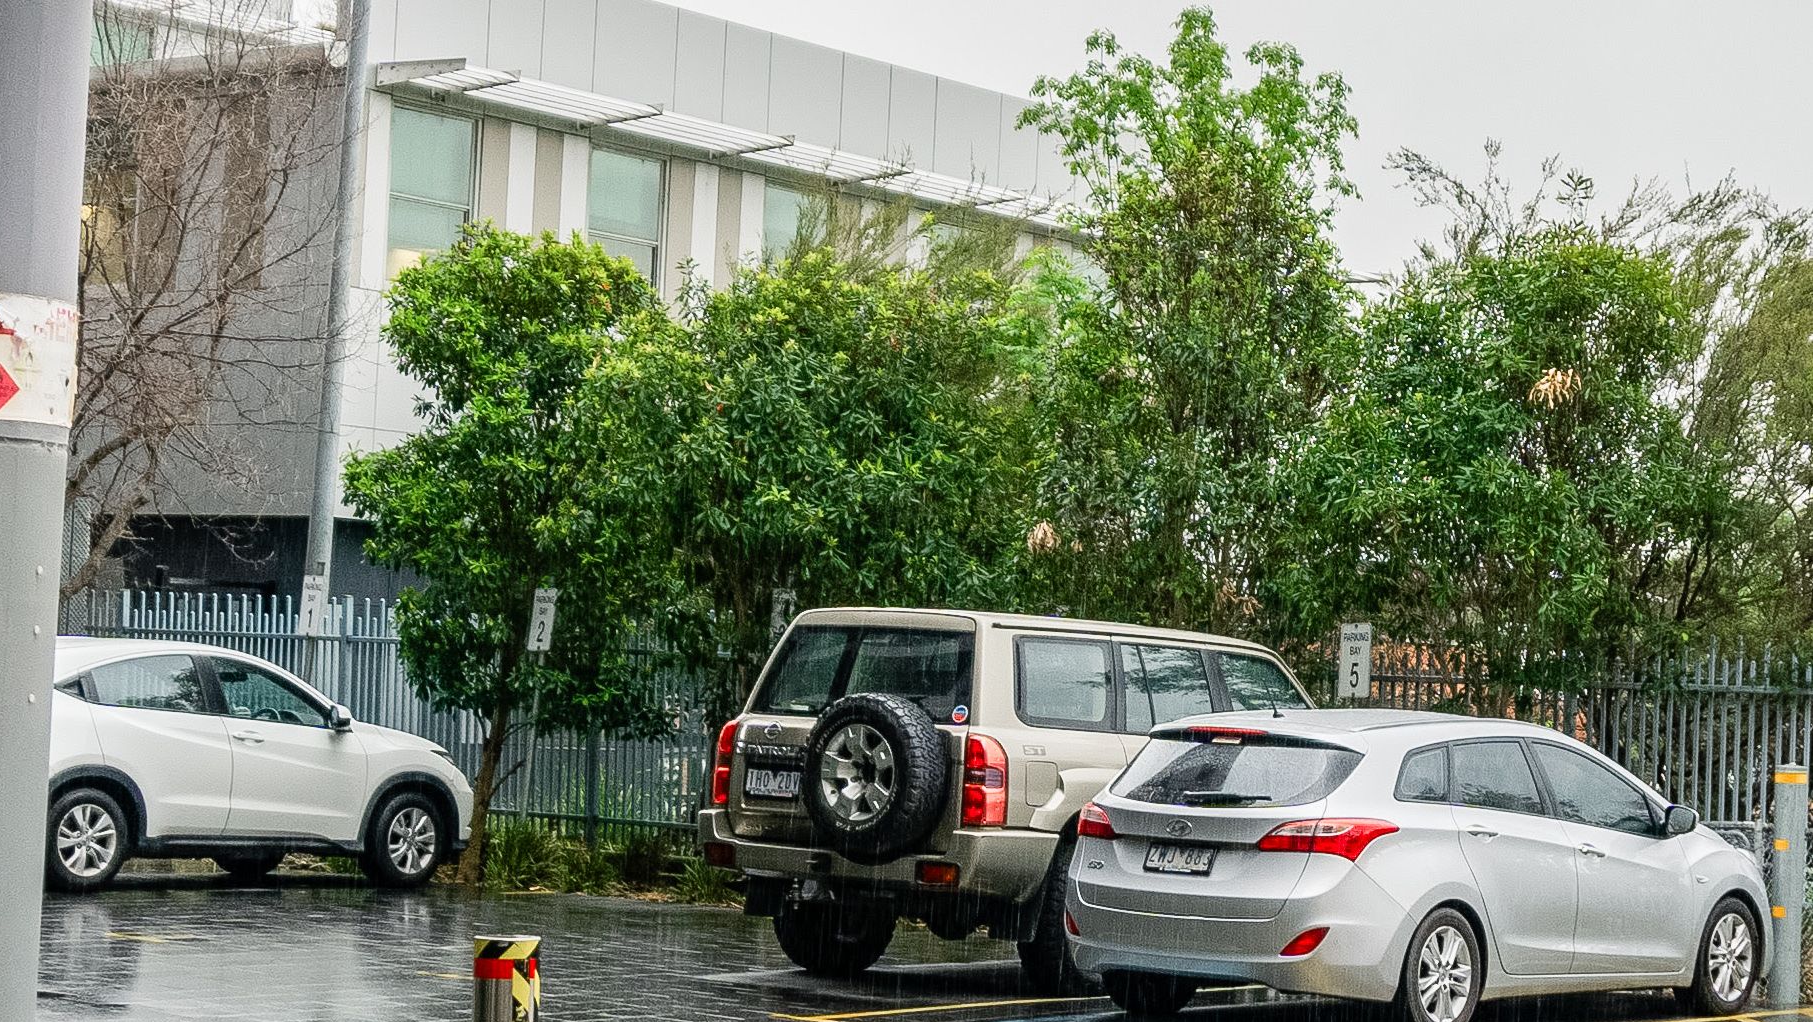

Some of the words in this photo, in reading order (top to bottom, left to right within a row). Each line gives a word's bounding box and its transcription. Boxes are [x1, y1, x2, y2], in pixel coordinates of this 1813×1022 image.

[308, 608, 313, 628] 1
[537, 620, 545, 642] 2
[1343, 632, 1369, 642] PARKING
[1349, 646, 1362, 656] BAY
[1349, 663, 1359, 688] 5
[747, 744, 795, 755] PATROL
